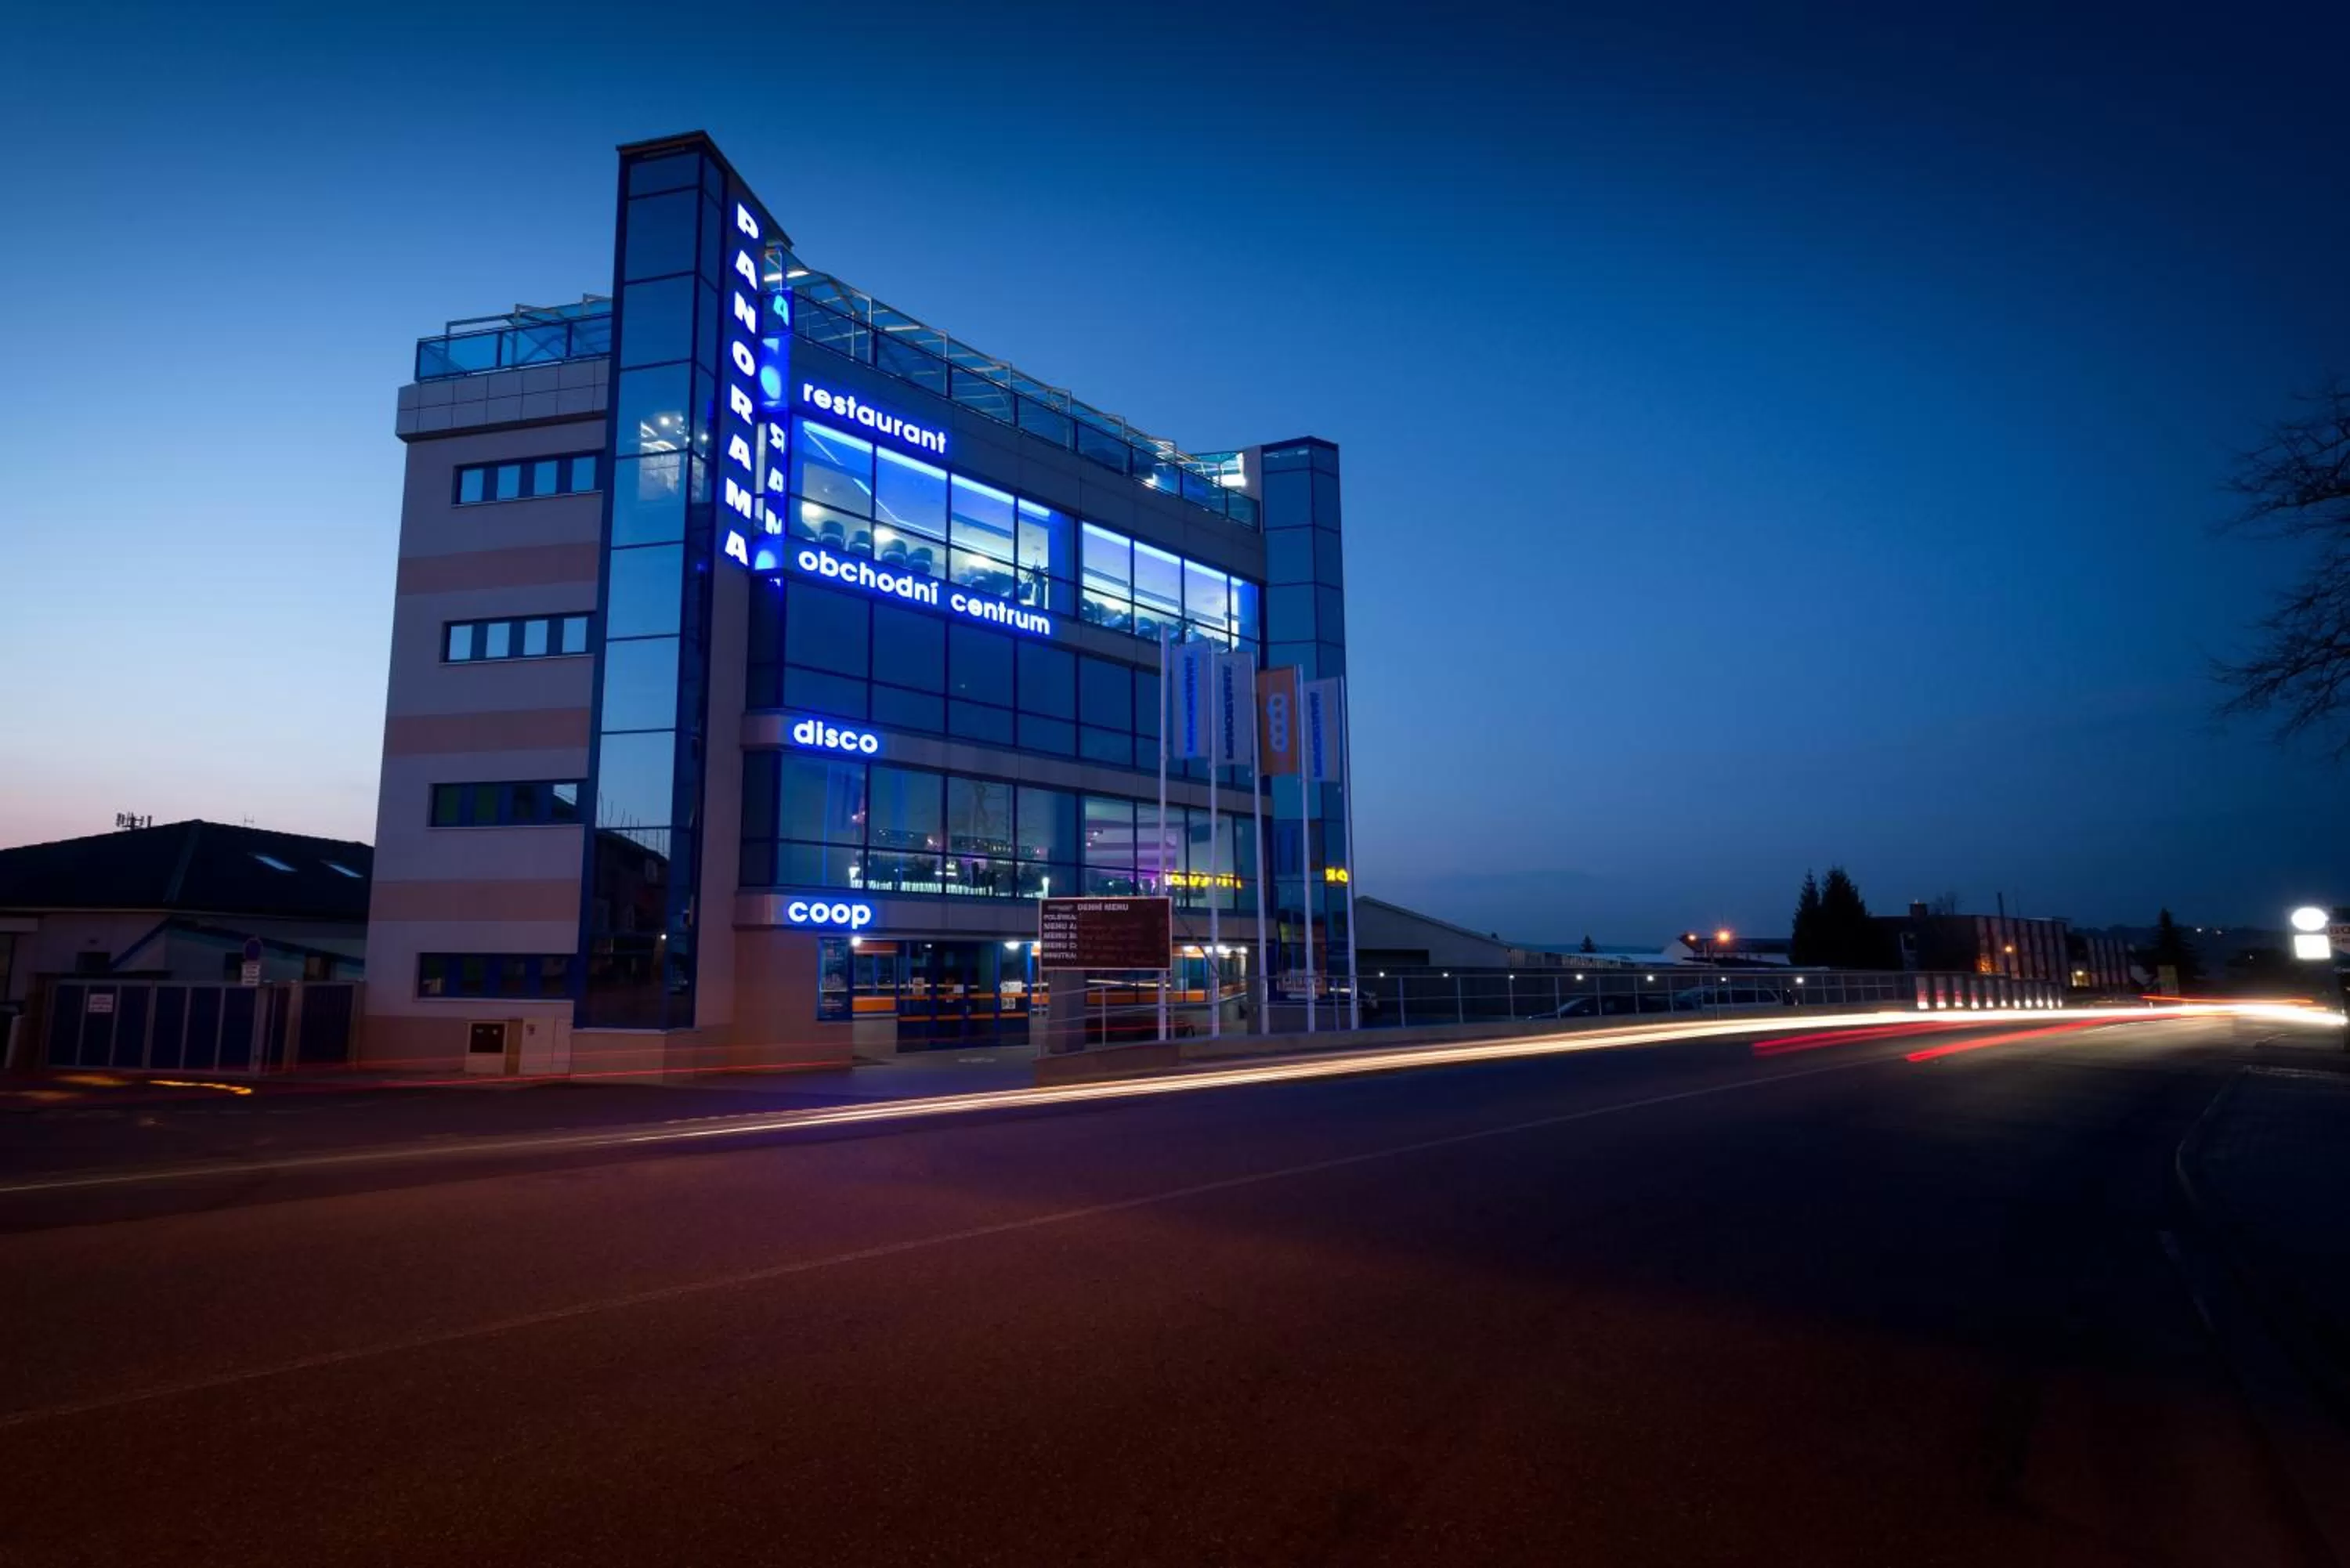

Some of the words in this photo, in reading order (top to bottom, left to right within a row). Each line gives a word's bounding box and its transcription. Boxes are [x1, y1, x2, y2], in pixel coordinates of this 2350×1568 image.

[725, 202, 760, 567] PANORAMA
[803, 382, 947, 454] restaurant
[797, 550, 938, 605] obchodní
[950, 593, 1051, 636] centrum
[793, 719, 879, 753] disco
[788, 901, 872, 930] coop
